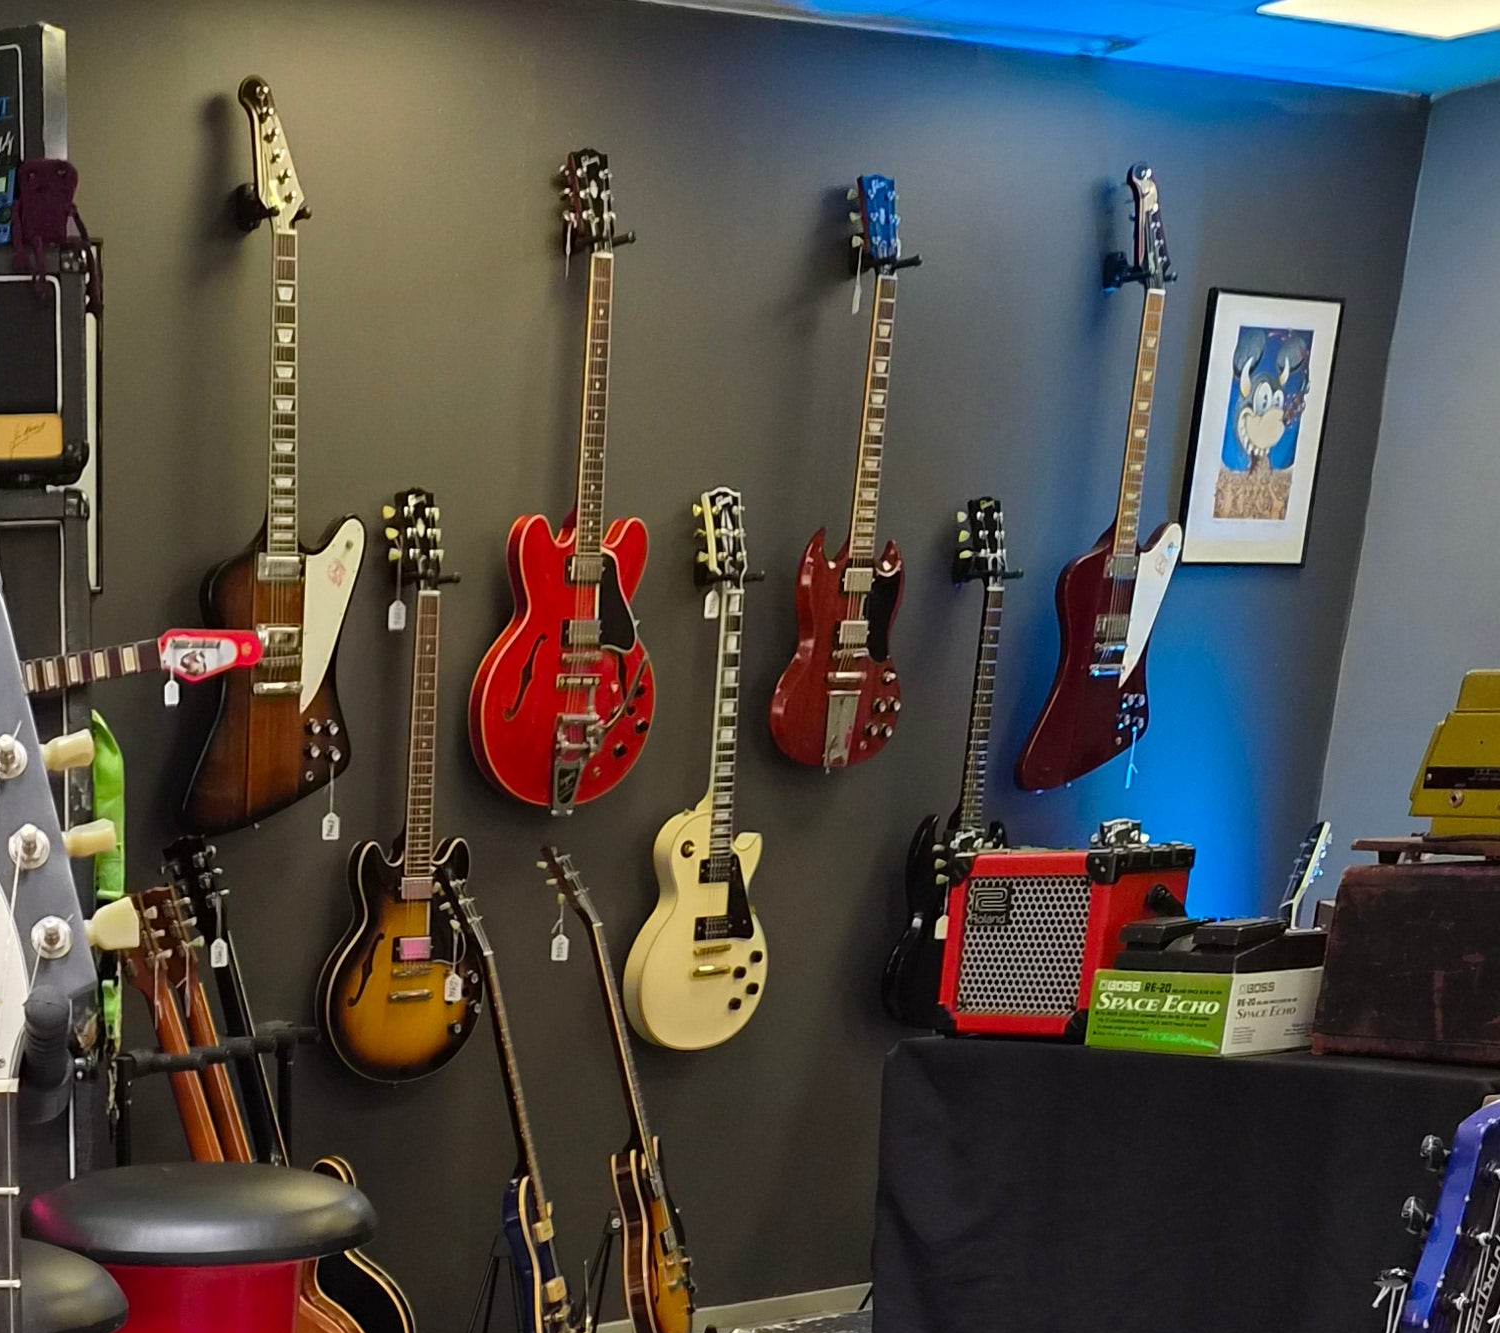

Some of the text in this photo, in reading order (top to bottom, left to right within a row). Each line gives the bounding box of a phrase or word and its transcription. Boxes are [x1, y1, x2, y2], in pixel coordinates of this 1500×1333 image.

[1107, 981, 1142, 992] BOSS
[1144, 982, 1172, 993] RE-20
[1246, 982, 1275, 994] BOSS
[1096, 992, 1220, 1015] SPACE ECHO
[1236, 1006, 1297, 1019] SPACE ECHO
